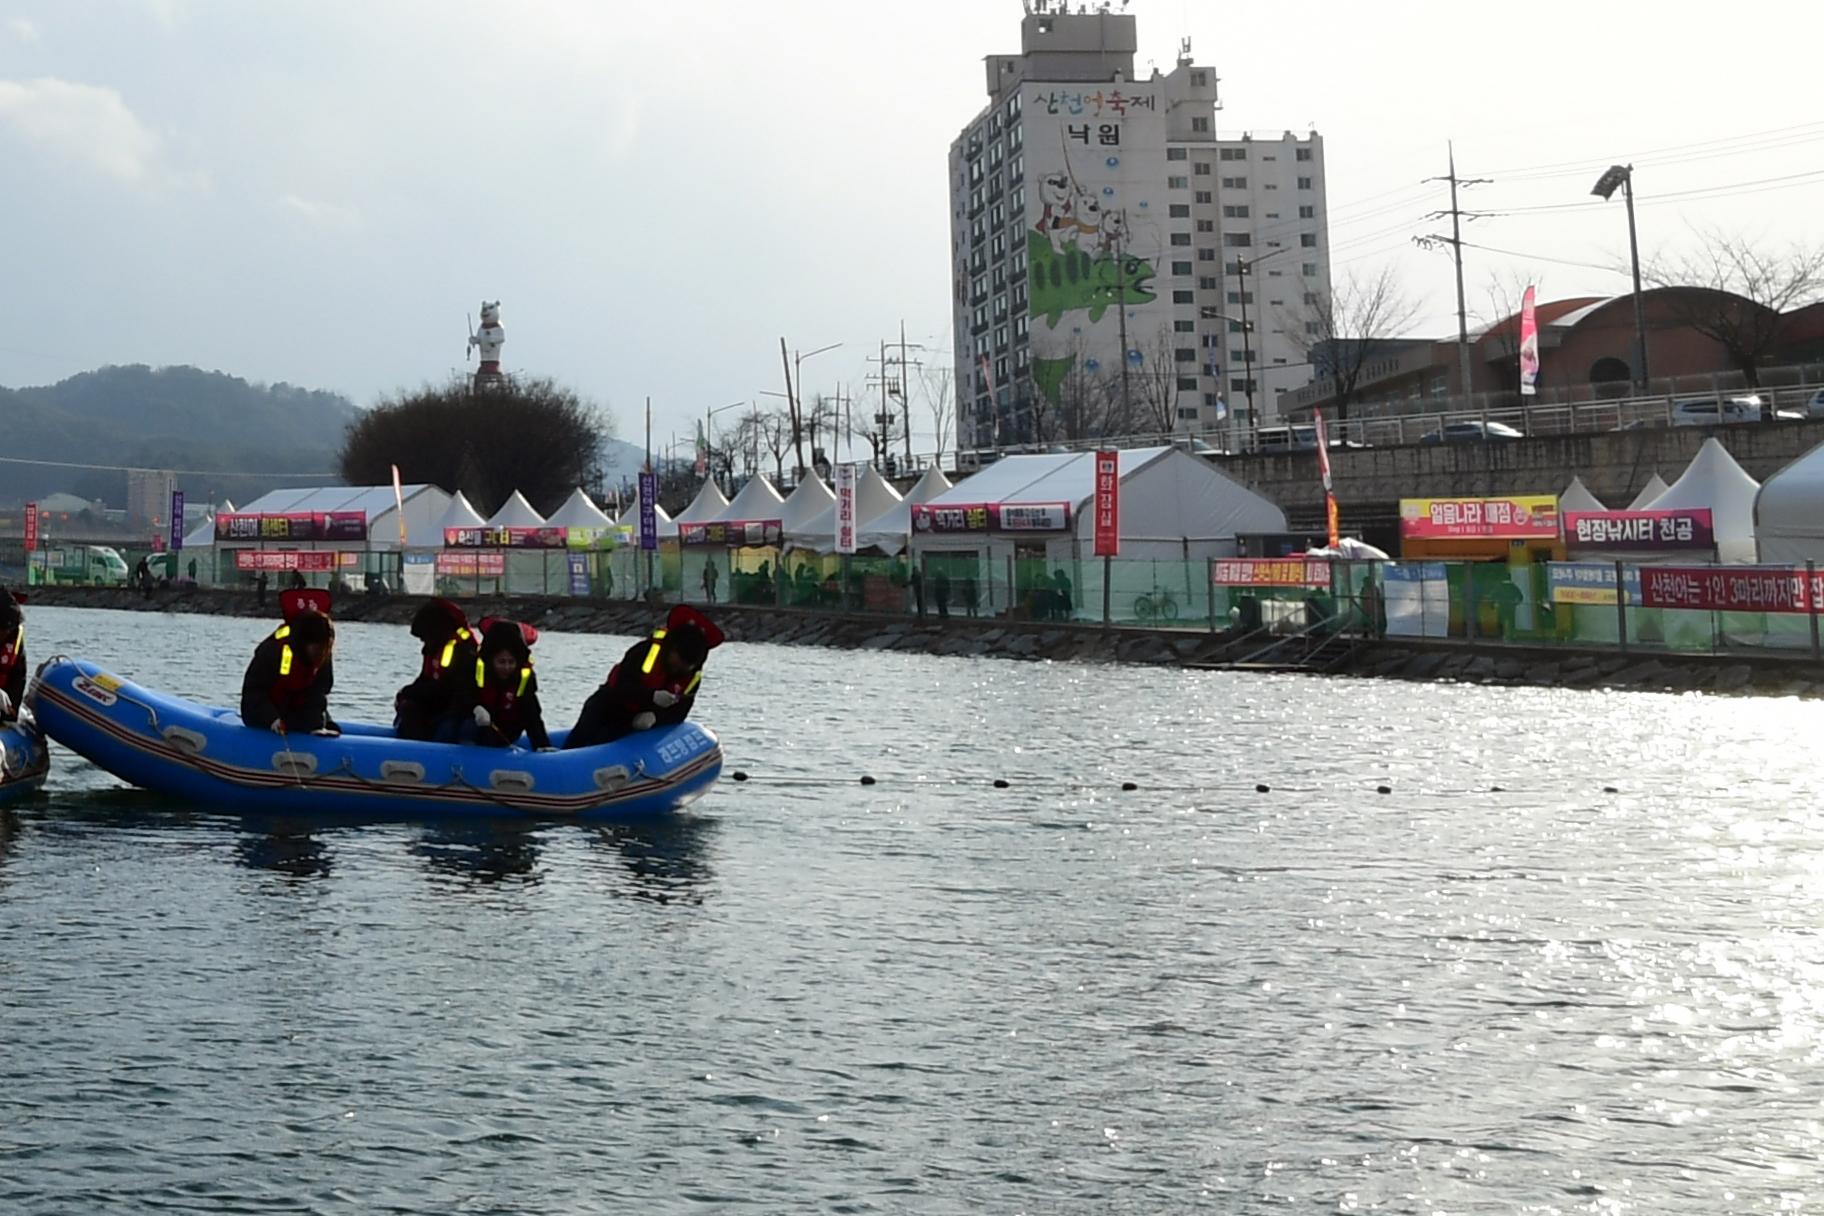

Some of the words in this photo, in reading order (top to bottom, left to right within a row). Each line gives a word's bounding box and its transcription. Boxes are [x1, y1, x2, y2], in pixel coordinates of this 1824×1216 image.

[1033, 90, 1156, 116] 산천어축제
[1068, 124, 1120, 146] 낙원
[934, 508, 965, 529] 먹거리
[1430, 502, 1482, 525] 얼음나라
[230, 518, 259, 538] 산천어
[1576, 518, 1654, 542] 현장낚시터
[1651, 573, 1702, 604] 산천어는
[1705, 575, 1726, 605] 1인
[1729, 576, 1805, 608] 3마리까지만
[657, 738, 689, 763] 래프팅
